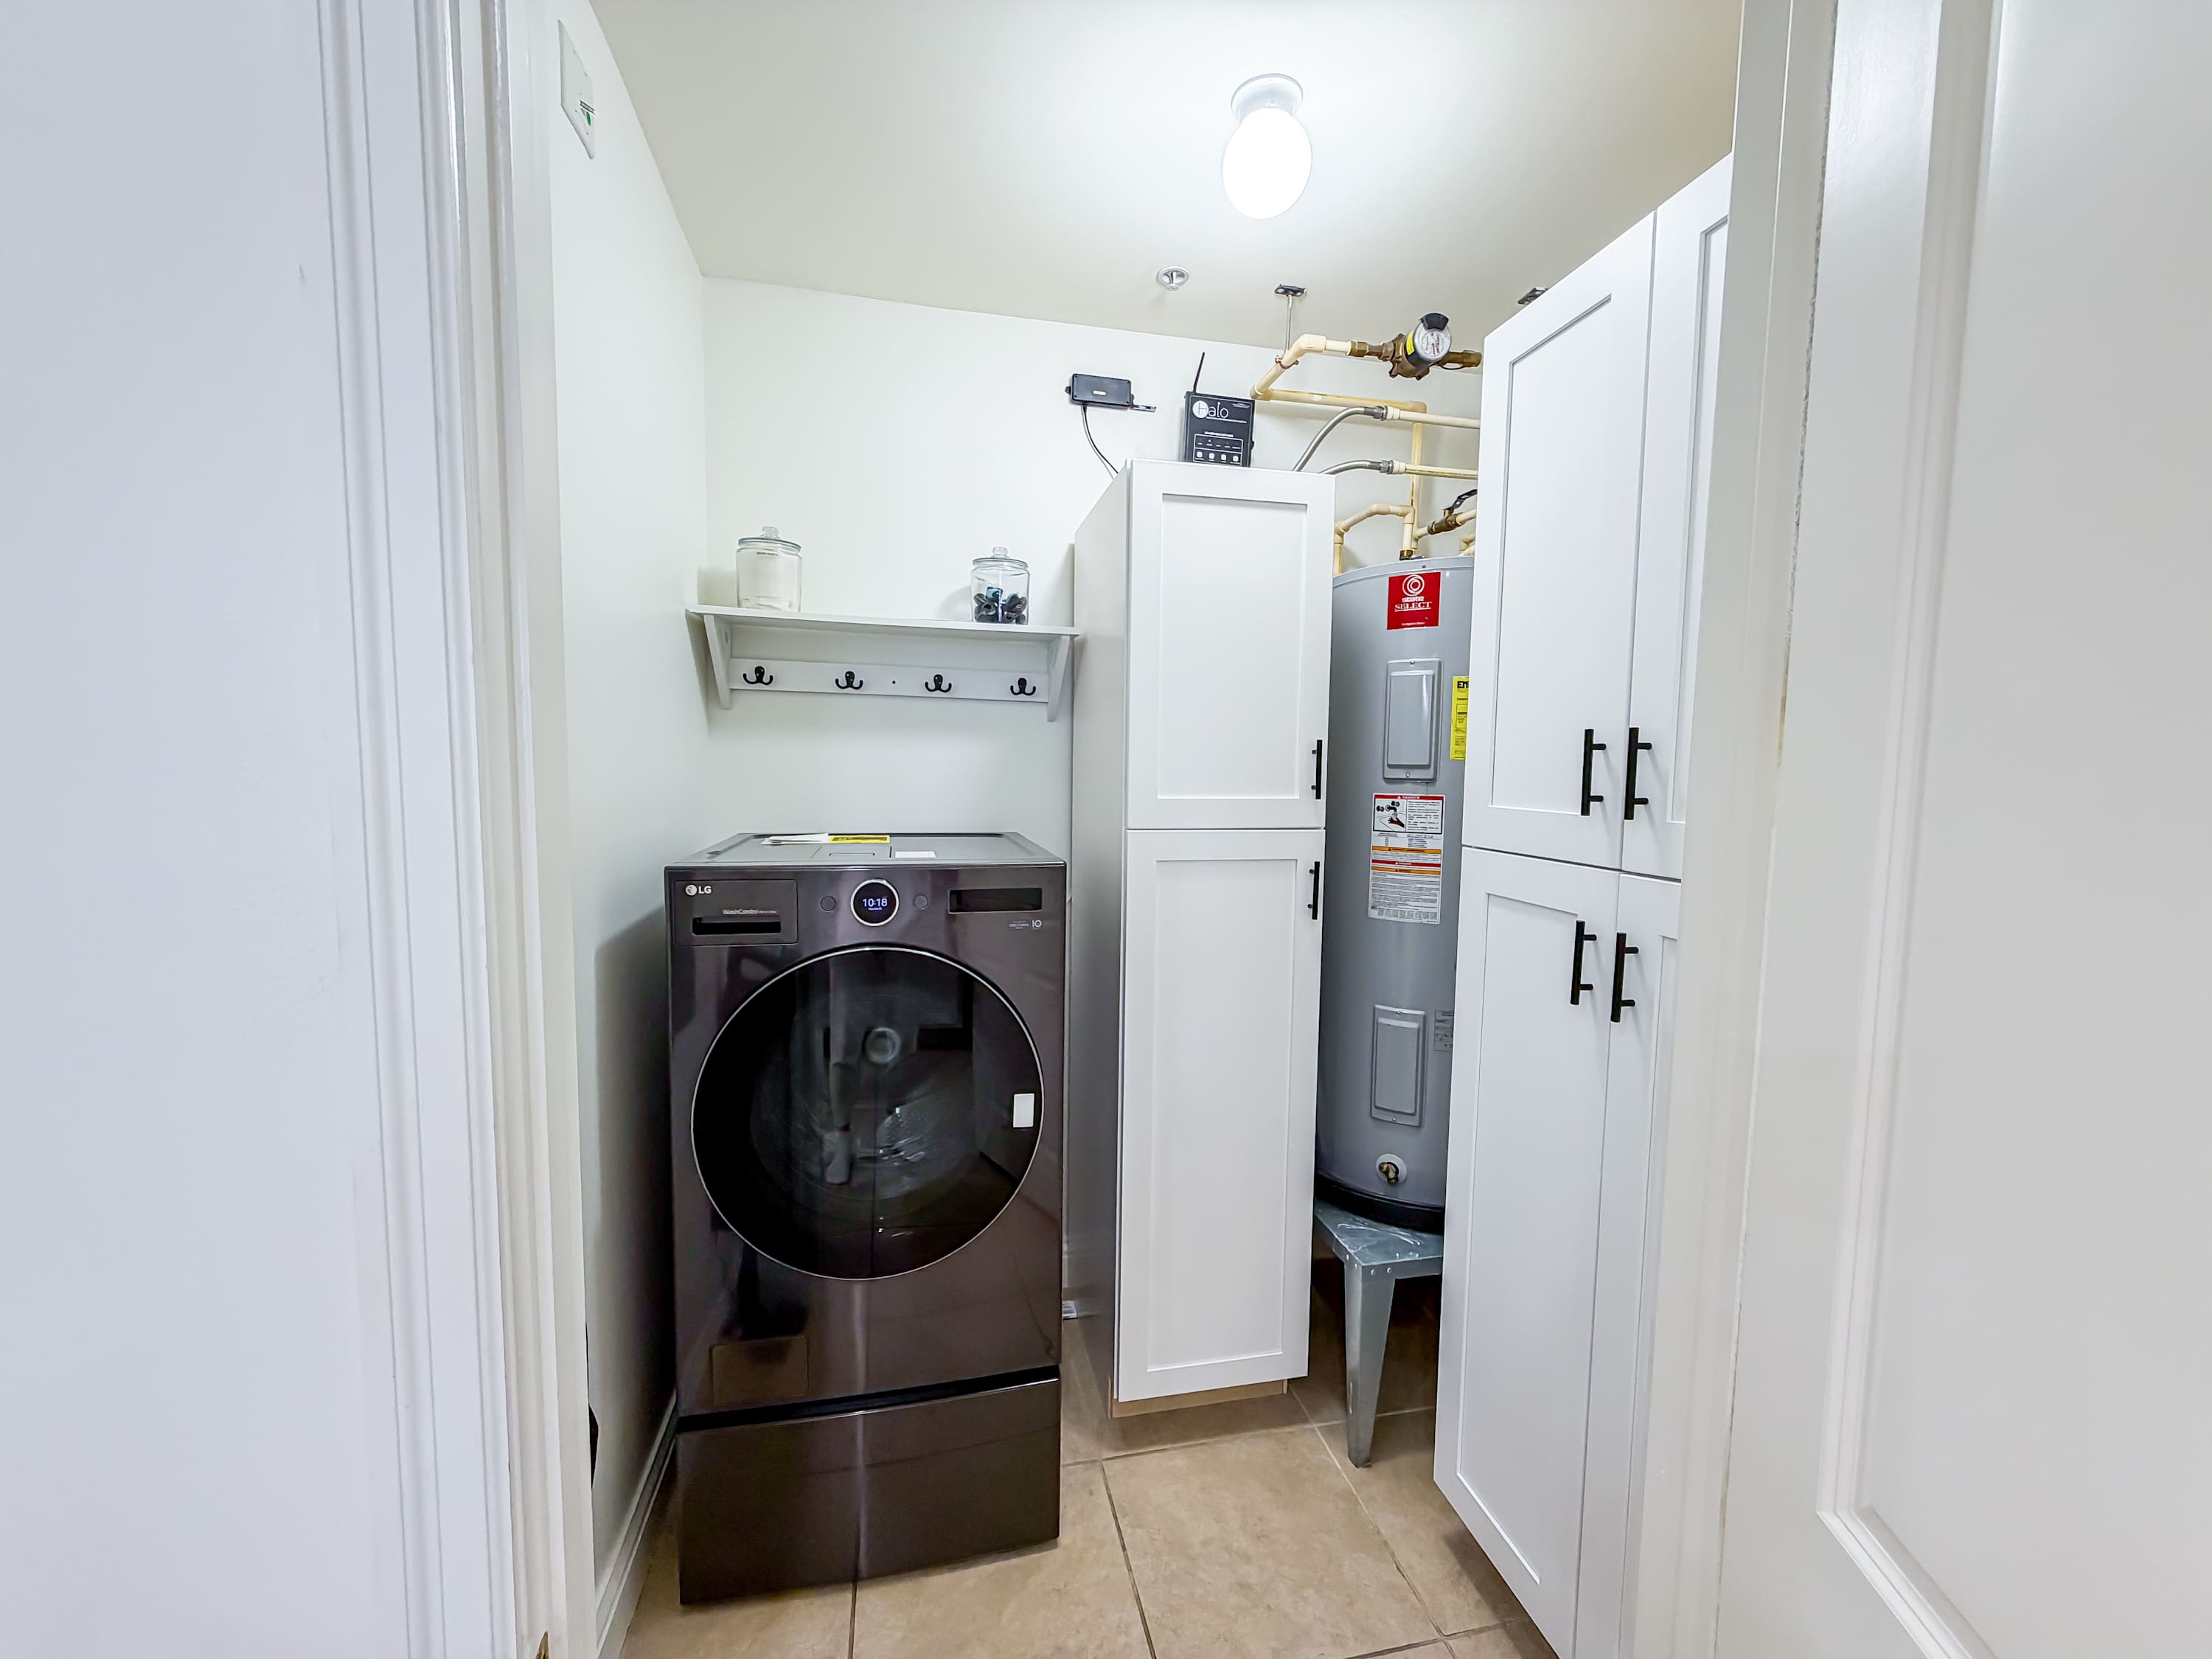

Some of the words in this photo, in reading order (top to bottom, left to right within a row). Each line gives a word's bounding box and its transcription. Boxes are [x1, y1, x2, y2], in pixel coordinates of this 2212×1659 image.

[1394, 601, 1433, 610] SELECT
[698, 886, 712, 894] LG
[862, 897, 888, 908] 10:18
